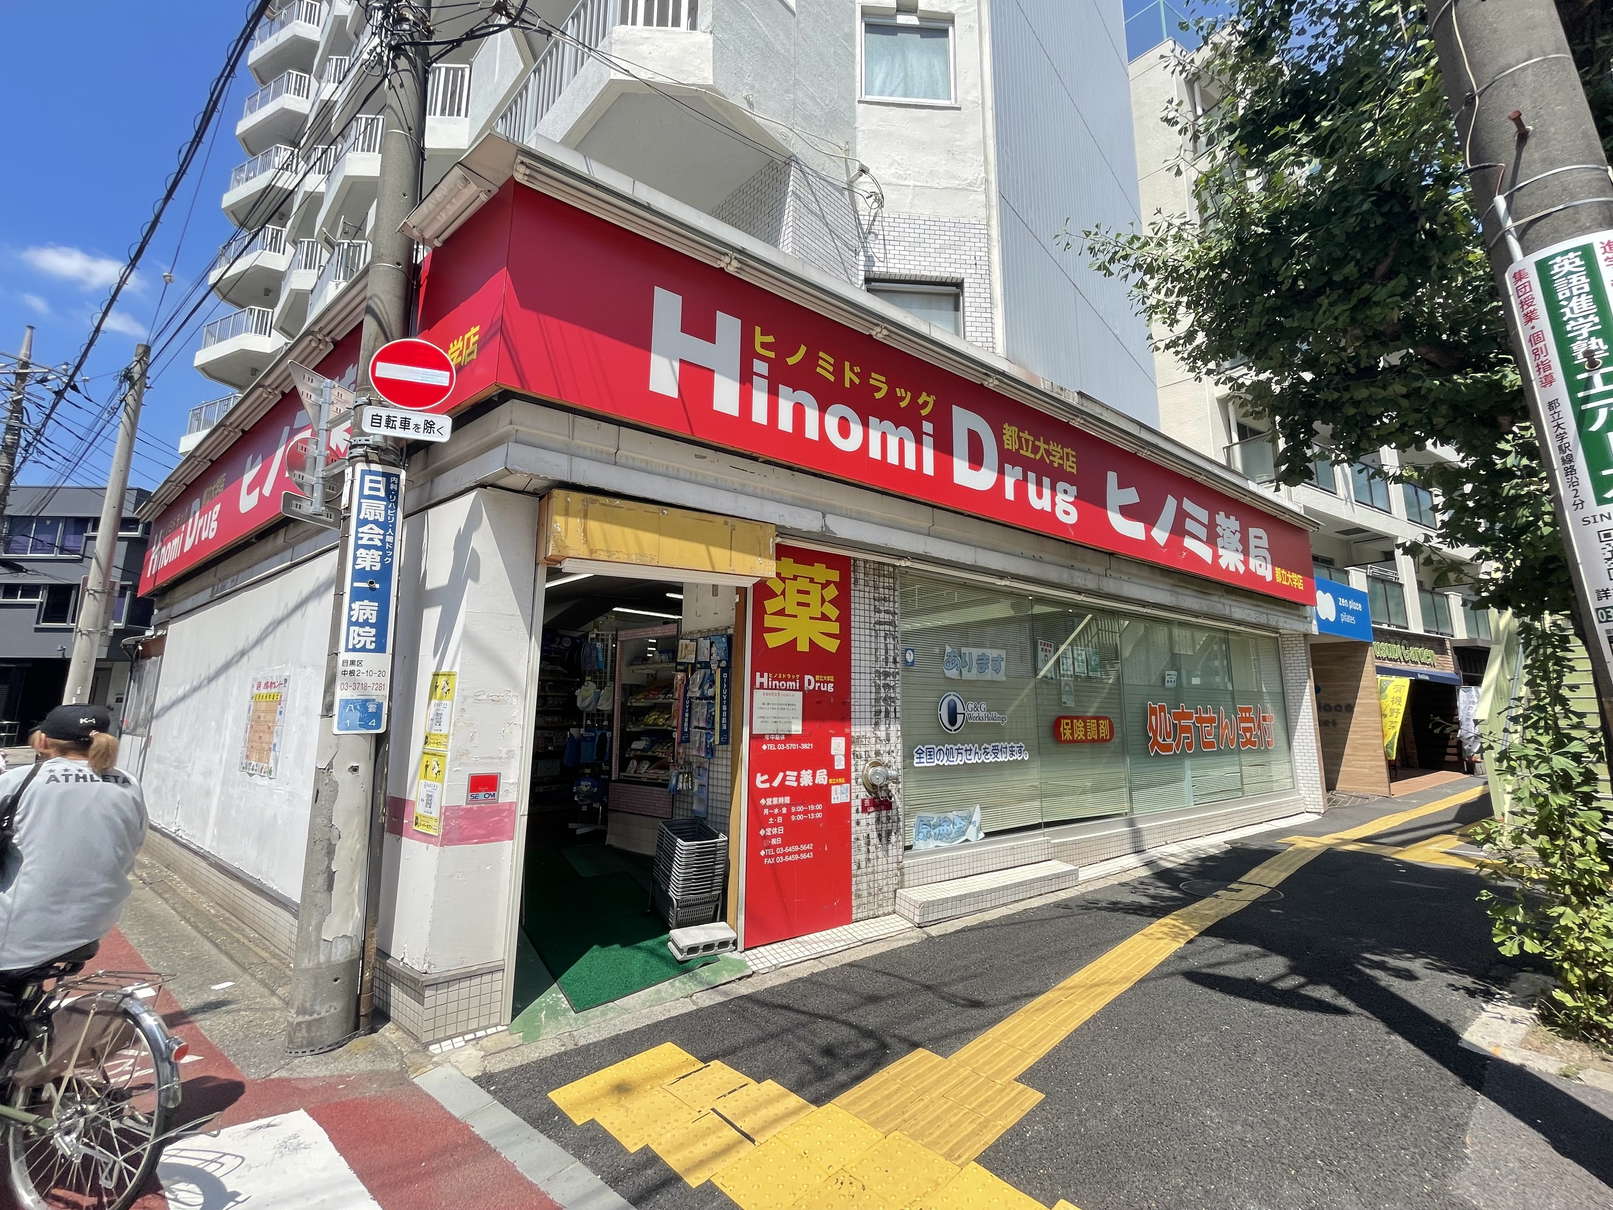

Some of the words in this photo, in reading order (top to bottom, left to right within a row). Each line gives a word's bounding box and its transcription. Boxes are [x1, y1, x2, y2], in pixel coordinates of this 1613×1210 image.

[1512, 268, 1557, 388] 集団授業・個別指導
[754, 325, 936, 416] ヒノミドラッグ
[370, 412, 445, 436] 自転車を除く
[648, 285, 935, 476] Hinomi
[952, 404, 1079, 525] Drug
[1002, 422, 1078, 475] 都立大学店
[1547, 398, 1585, 511] 都立大学駅線路沿2分
[1106, 470, 1273, 582] ヒノミ薬局
[347, 474, 387, 650] 日扇会第一病院
[763, 556, 841, 653] 薬
[755, 672, 800, 690] Hinomi
[804, 675, 834, 692] Drug
[943, 650, 1004, 674] あります
[914, 742, 1030, 766] 全国の処方せんを受付ます。
[1060, 719, 1110, 741] 保険調剤
[1146, 701, 1276, 756] 処方せん受付
[755, 769, 828, 788] ヒノミ薬局
